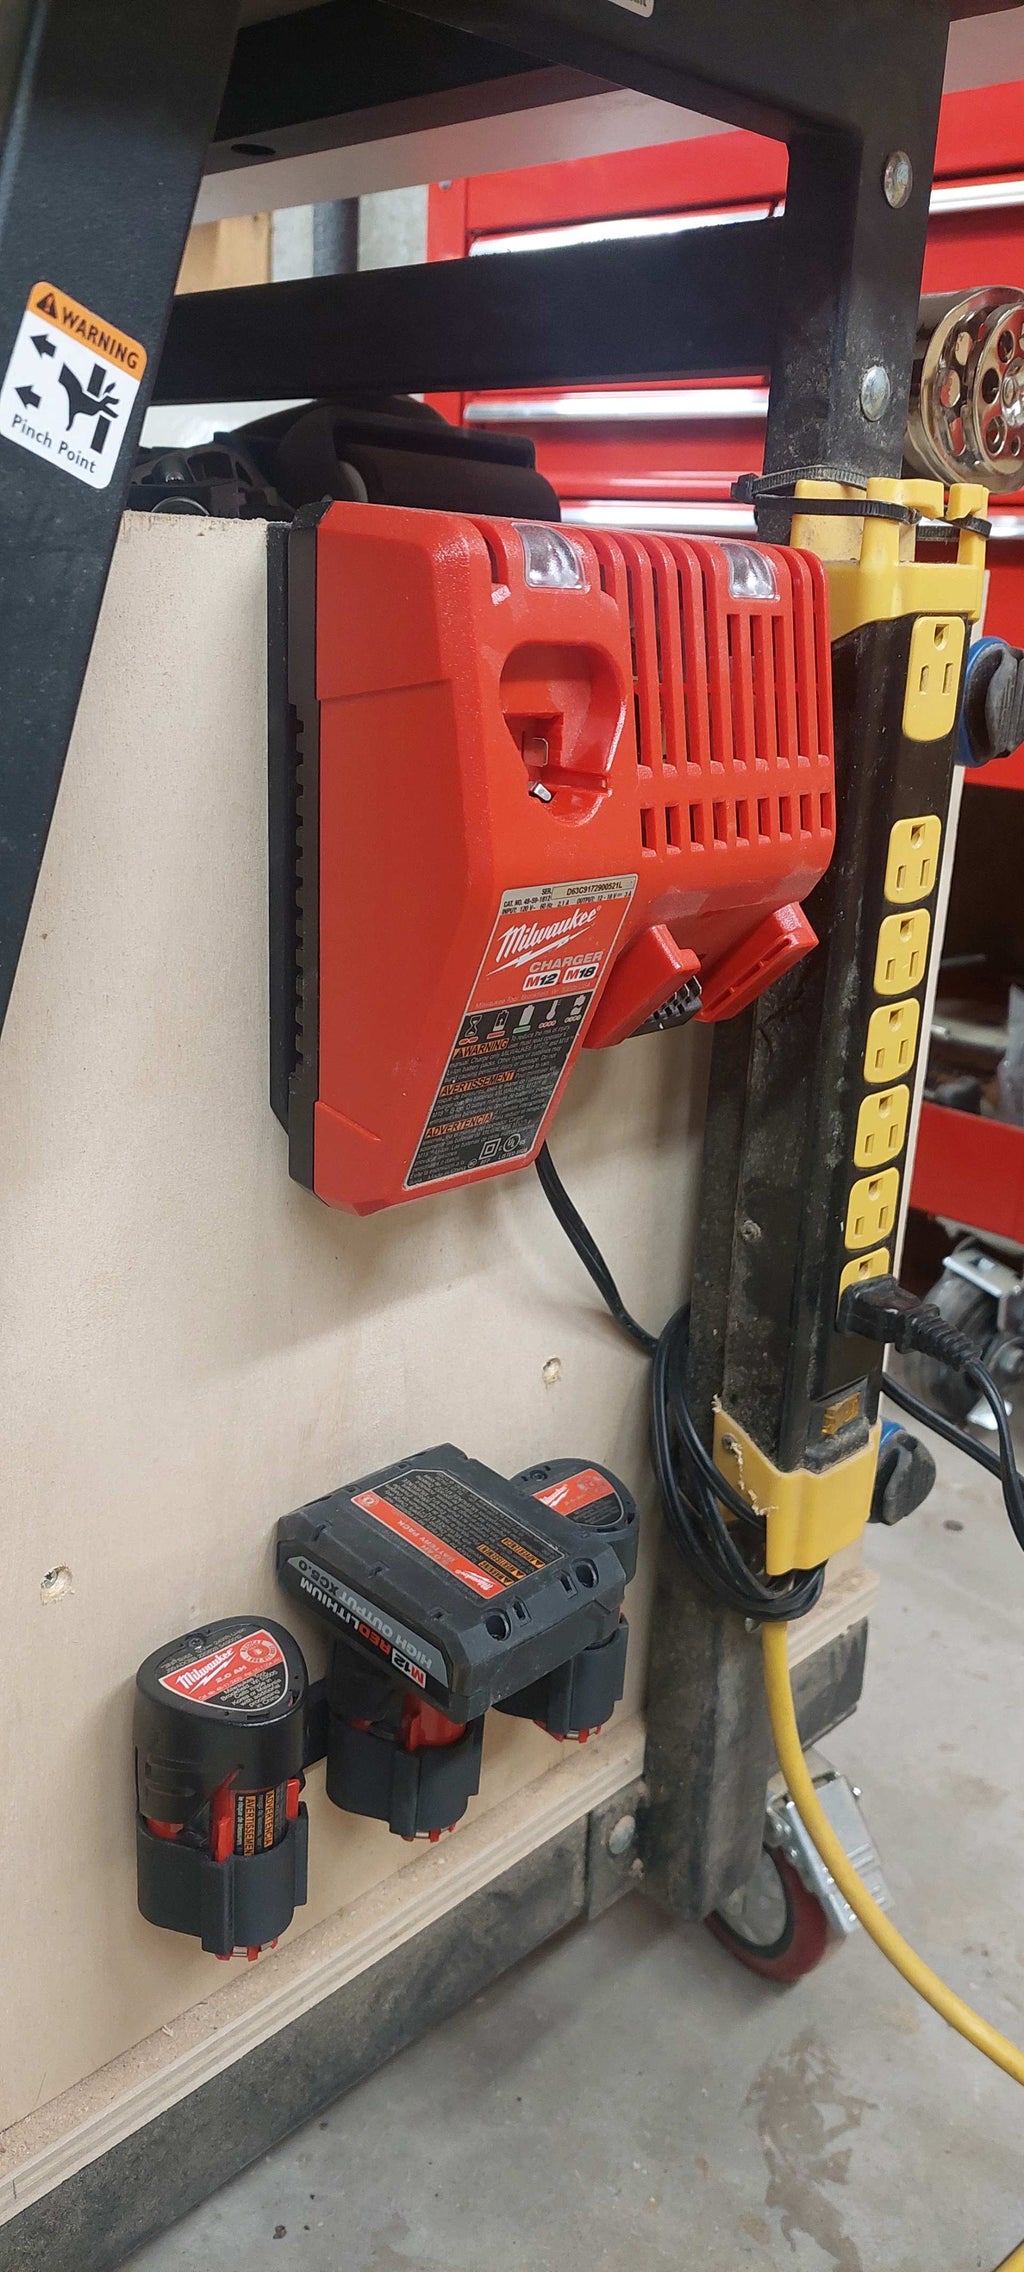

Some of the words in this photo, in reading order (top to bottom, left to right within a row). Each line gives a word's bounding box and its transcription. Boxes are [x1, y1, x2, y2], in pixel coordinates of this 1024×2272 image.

[62, 306, 139, 370] WARNING
[11, 414, 53, 449] Pinch
[58, 440, 97, 474] Point
[496, 907, 598, 963] Milwaukee
[524, 972, 558, 989] M12
[564, 965, 597, 981] M18
[529, 951, 604, 973] CHARGER
[463, 1039, 509, 1056] WARNING
[441, 1071, 514, 1096] AVERTISSEMENT
[426, 1113, 493, 1137] ADVERTENCIA
[298, 1560, 339, 1595] XC5.0
[300, 1577, 391, 1656] REDLITHIUM
[338, 1591, 393, 1637] OUTPUT
[176, 1647, 234, 1689] Milwaukee
[393, 1652, 425, 1685] M12
[395, 1635, 433, 1669] HIGH
[215, 1672, 232, 1683] 2.0
[244, 1798, 255, 1855] AVERTISSEMEN
[264, 1792, 275, 1846] ADVERTENCIA
